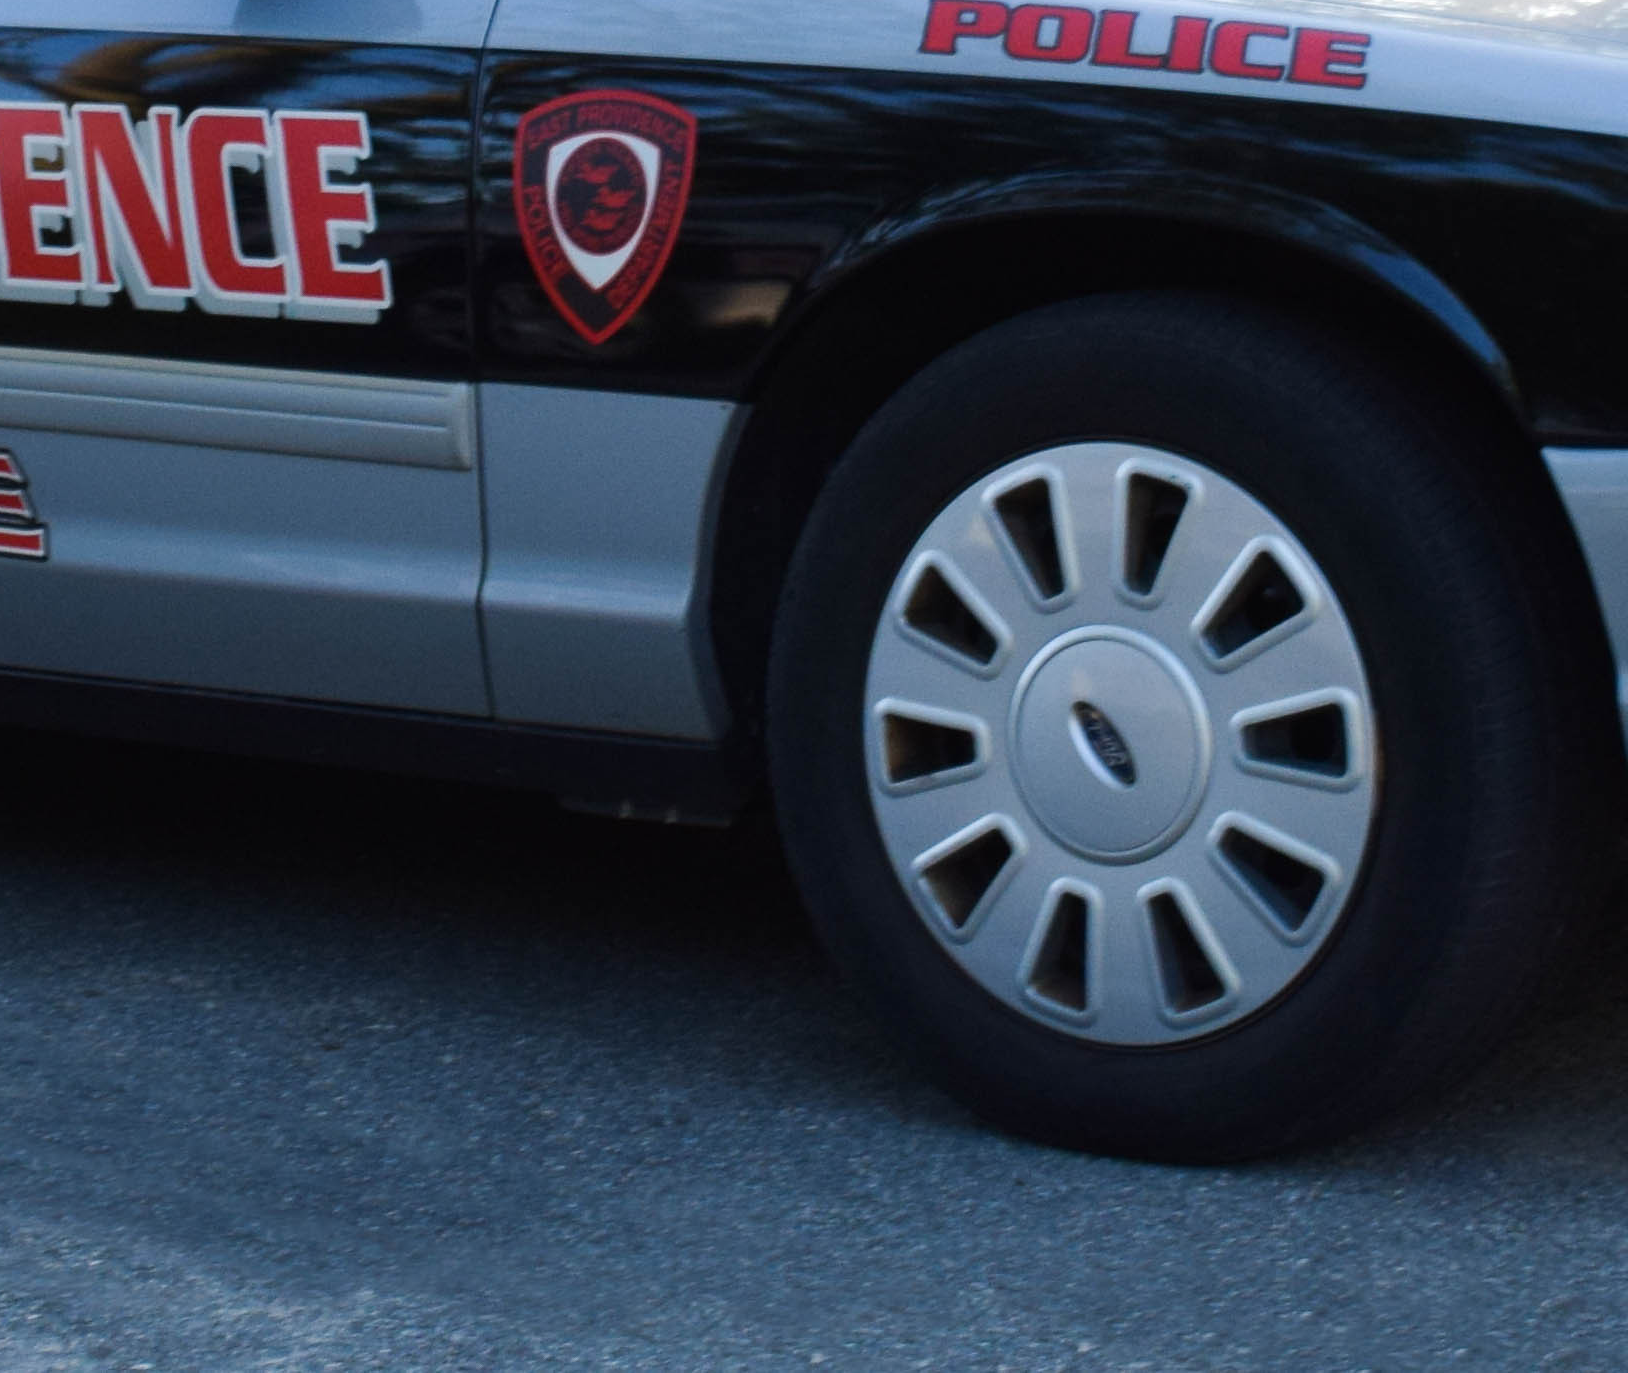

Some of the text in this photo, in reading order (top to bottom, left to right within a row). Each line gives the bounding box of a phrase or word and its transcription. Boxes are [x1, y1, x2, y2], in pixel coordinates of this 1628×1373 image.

[525, 103, 687, 151] EAST PROVIDENCE
[523, 185, 570, 282] POLICE
[606, 162, 682, 310] DEPARTMENT
